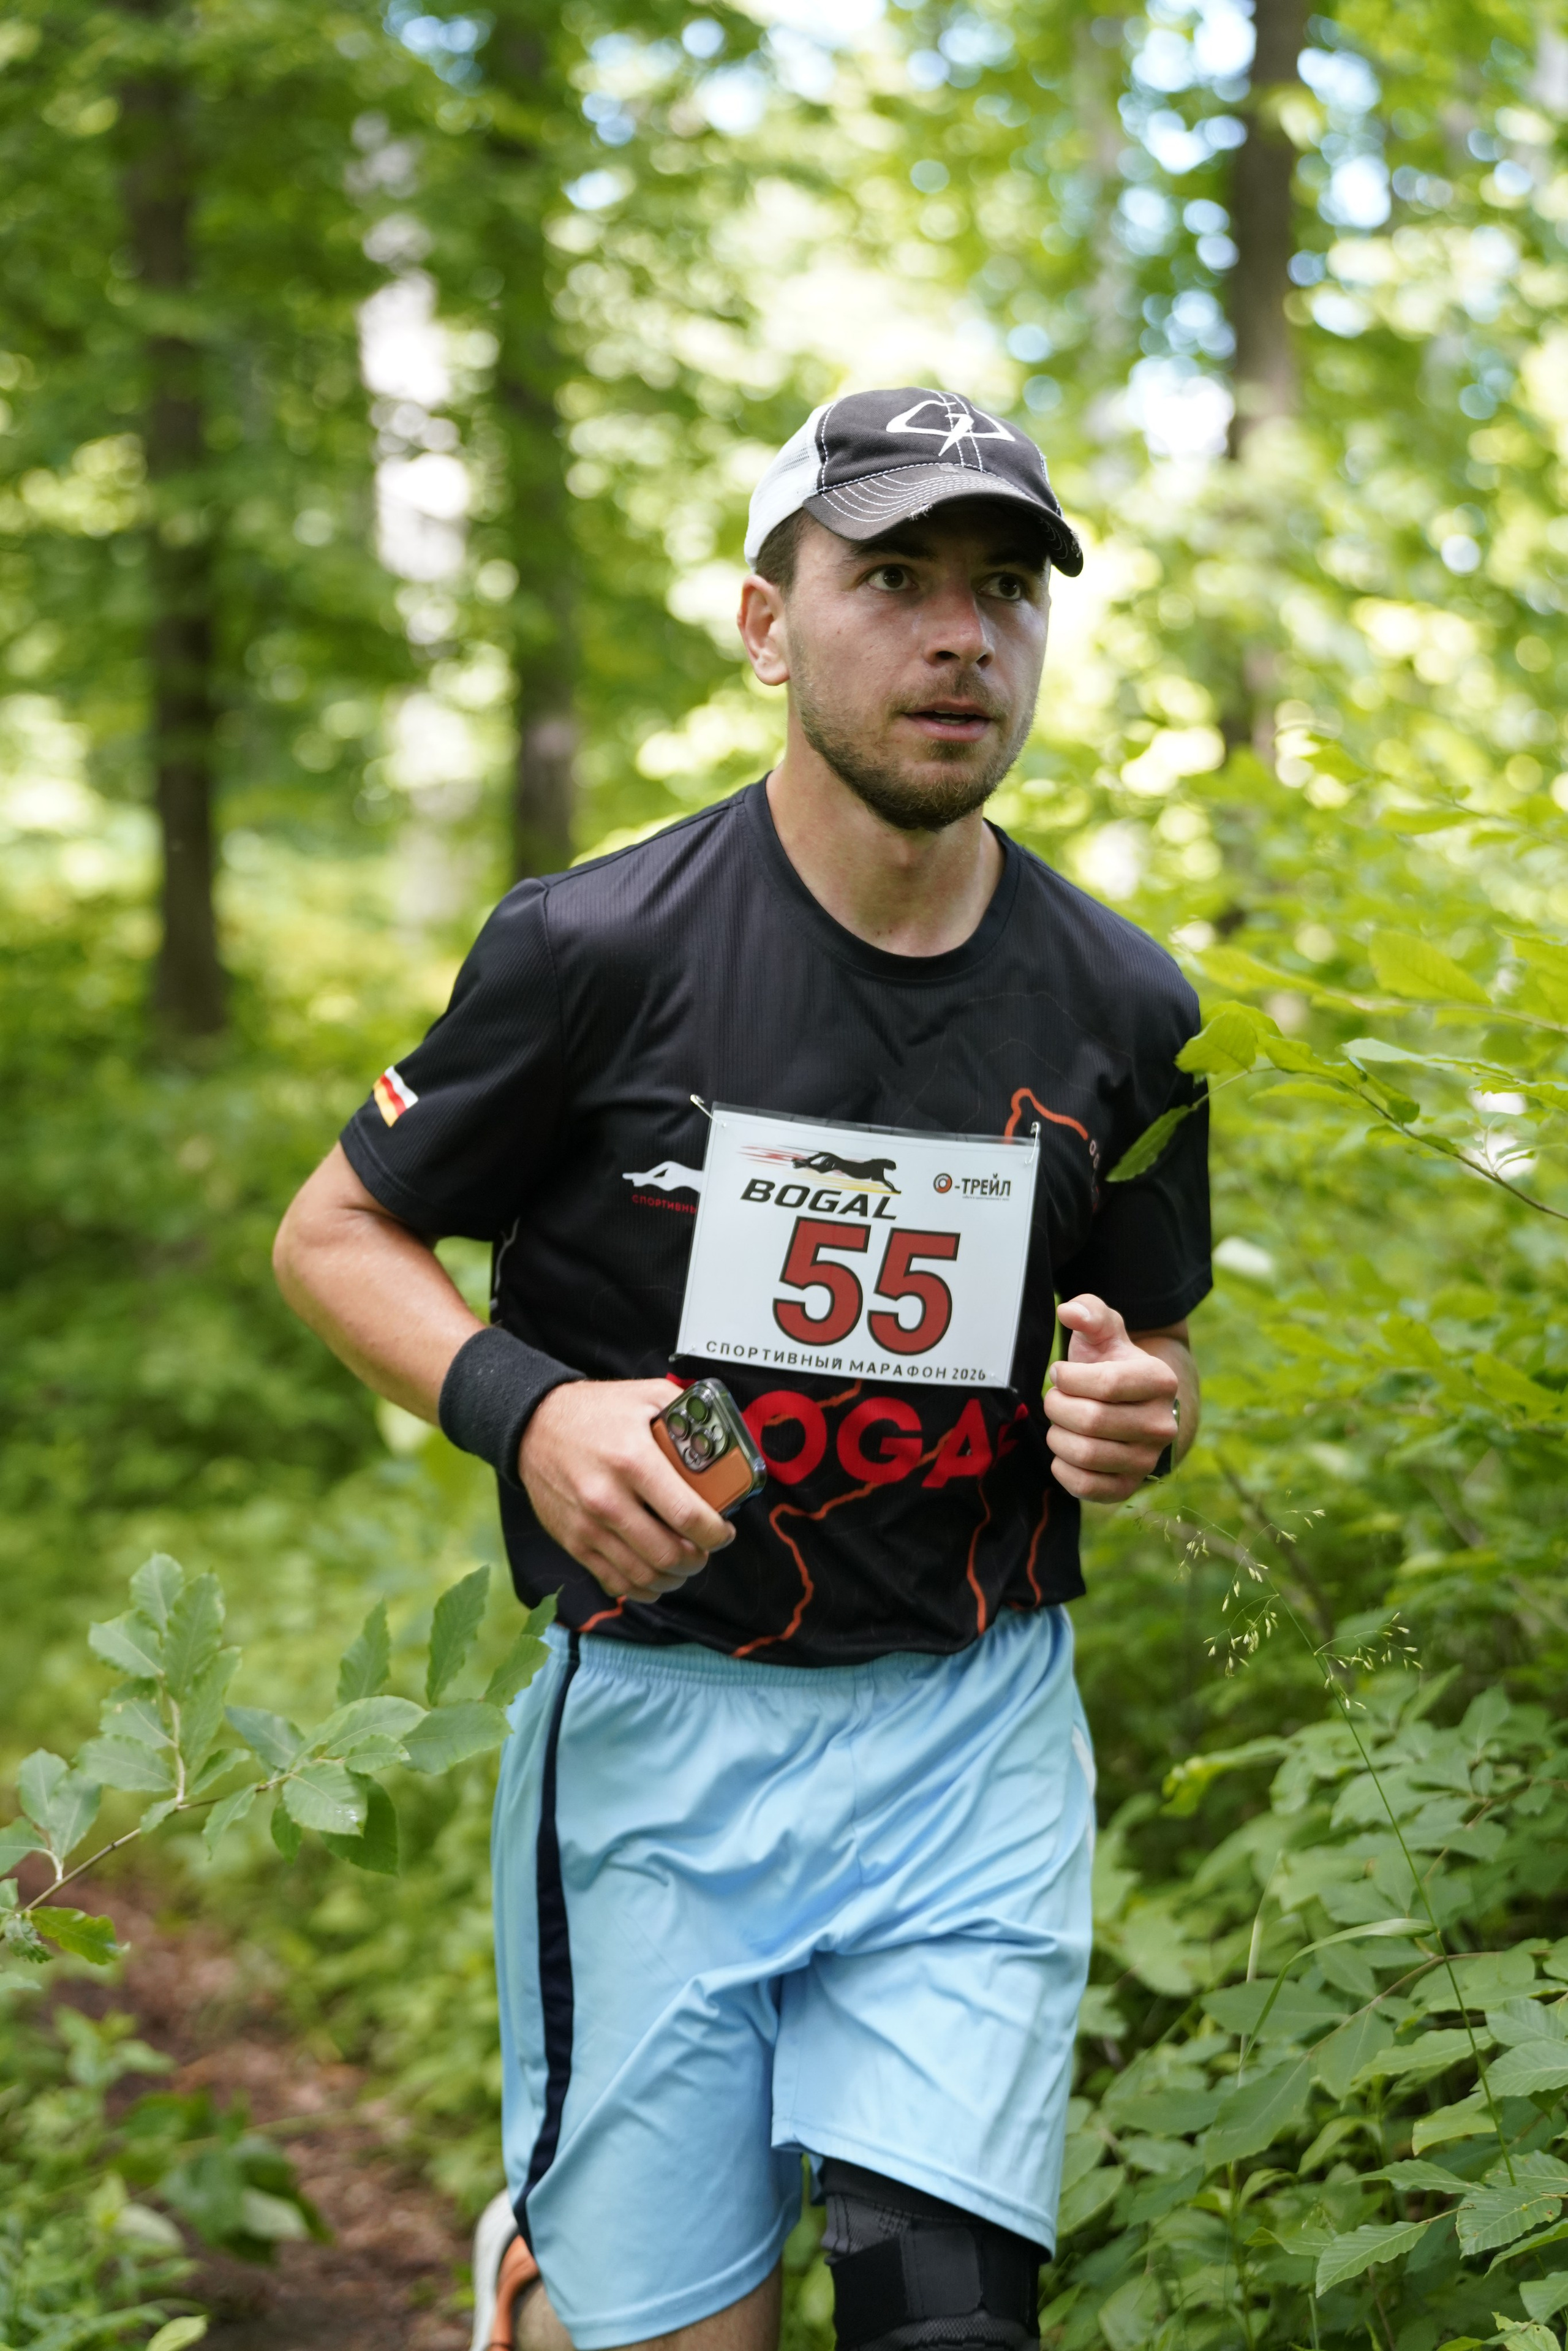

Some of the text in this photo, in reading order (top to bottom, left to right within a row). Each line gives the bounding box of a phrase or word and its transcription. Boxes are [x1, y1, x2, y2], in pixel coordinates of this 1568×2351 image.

[740, 1178, 897, 1220] BOGAL
[772, 1215, 960, 1356] 55
[706, 1340, 986, 1381] СПОРТИВНЫЙ МАРАФОН 2026
[666, 1372, 1028, 1487] OGA
